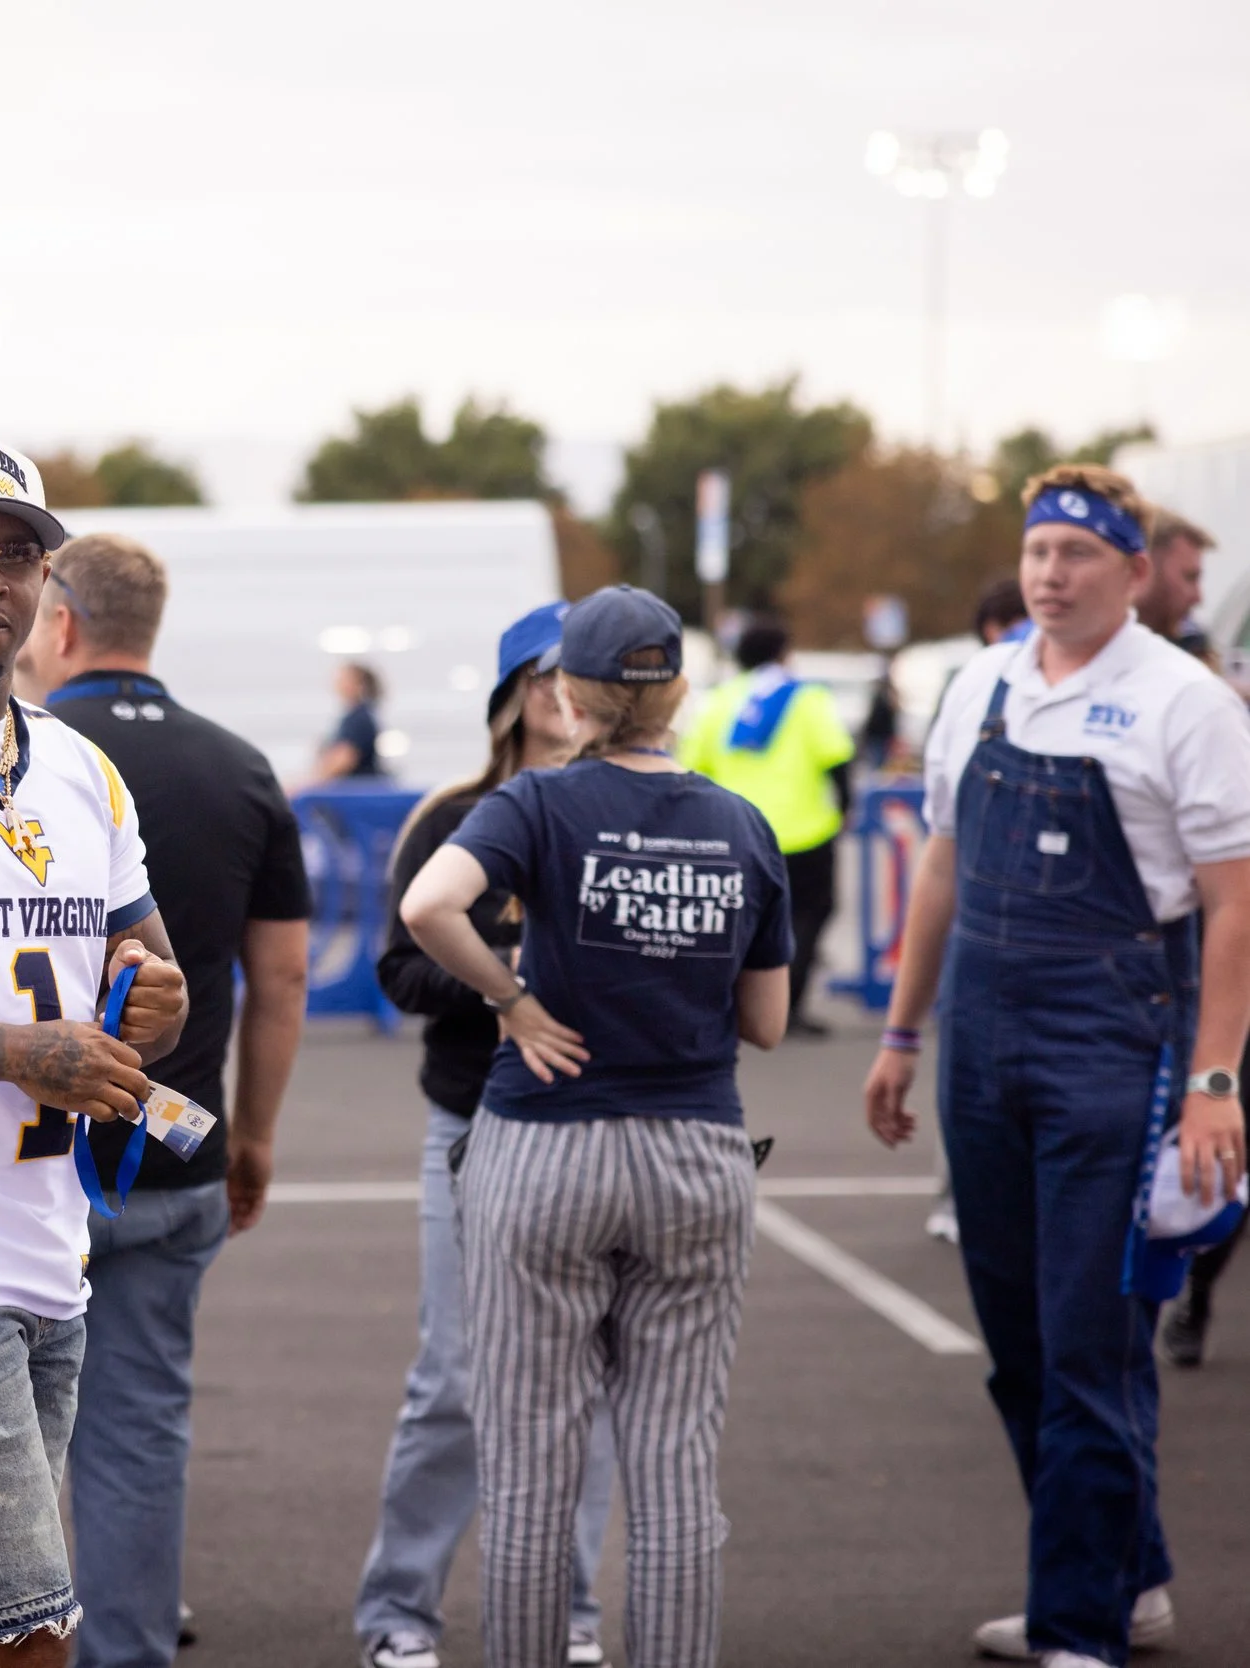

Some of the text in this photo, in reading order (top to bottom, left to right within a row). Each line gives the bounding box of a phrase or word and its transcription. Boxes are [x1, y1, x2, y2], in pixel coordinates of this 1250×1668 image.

[580, 855, 745, 909] Leading
[579, 886, 726, 934] by Faith
